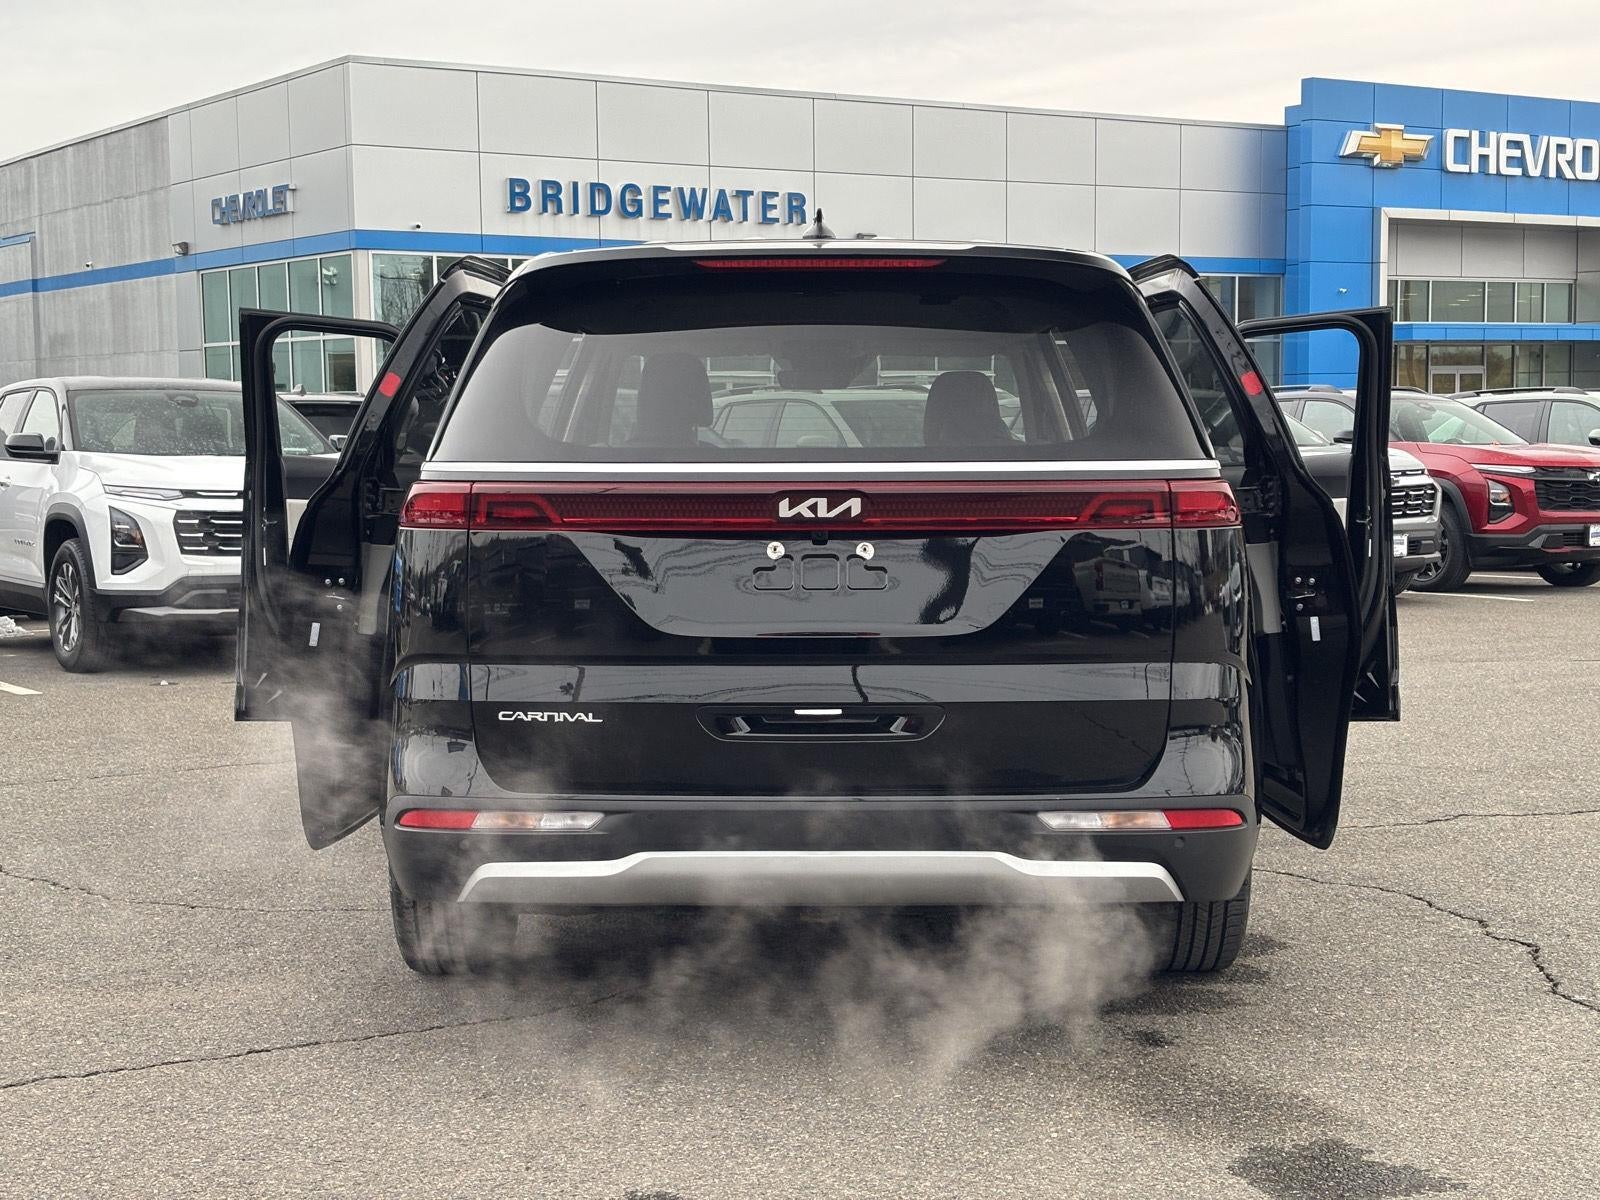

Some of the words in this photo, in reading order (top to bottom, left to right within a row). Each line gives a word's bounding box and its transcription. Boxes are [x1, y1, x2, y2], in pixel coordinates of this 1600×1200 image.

[1444, 128, 1599, 181] CHEVRO
[211, 184, 294, 225] CHEVROLET
[506, 177, 808, 225] BRIDGEWATER
[778, 497, 862, 518] KIA
[498, 711, 603, 723] CARNIVAL
